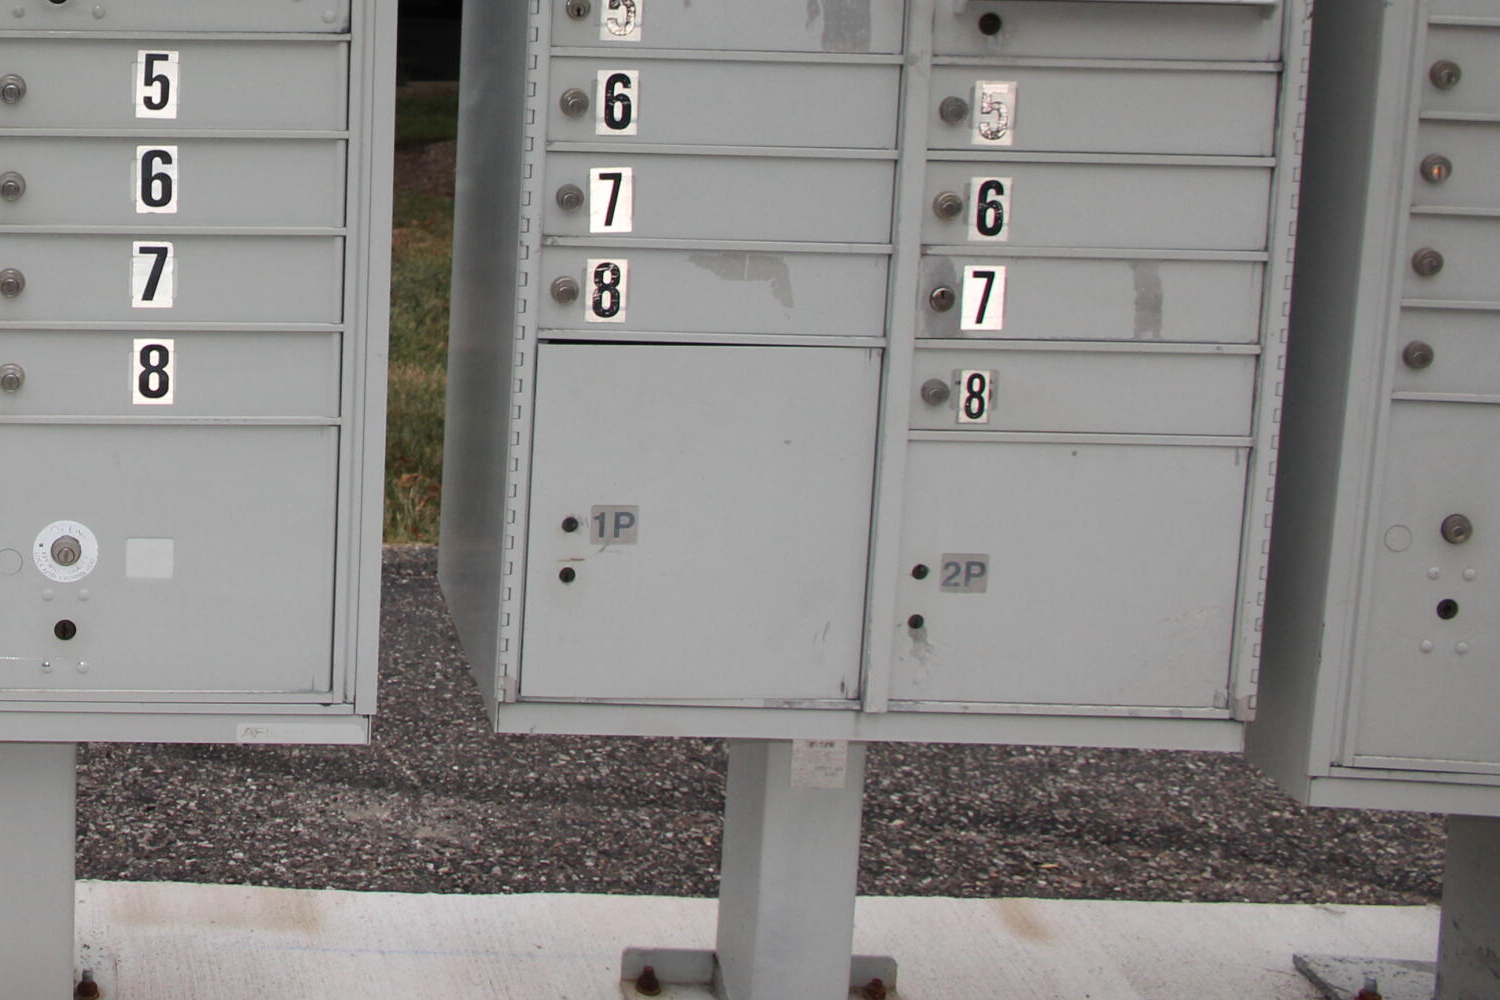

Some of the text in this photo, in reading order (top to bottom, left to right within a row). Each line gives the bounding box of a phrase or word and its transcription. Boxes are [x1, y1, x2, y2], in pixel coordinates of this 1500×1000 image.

[143, 53, 170, 111] 5
[604, 72, 632, 130] 6
[141, 149, 173, 208] 6
[598, 172, 623, 227] 7
[976, 179, 1004, 237] 6
[138, 246, 169, 301] 7
[592, 262, 621, 319] 8
[972, 270, 996, 325] 7
[138, 344, 170, 399] 8
[964, 372, 986, 420] 8
[593, 511, 635, 538] 1P
[943, 560, 987, 587] 2P
